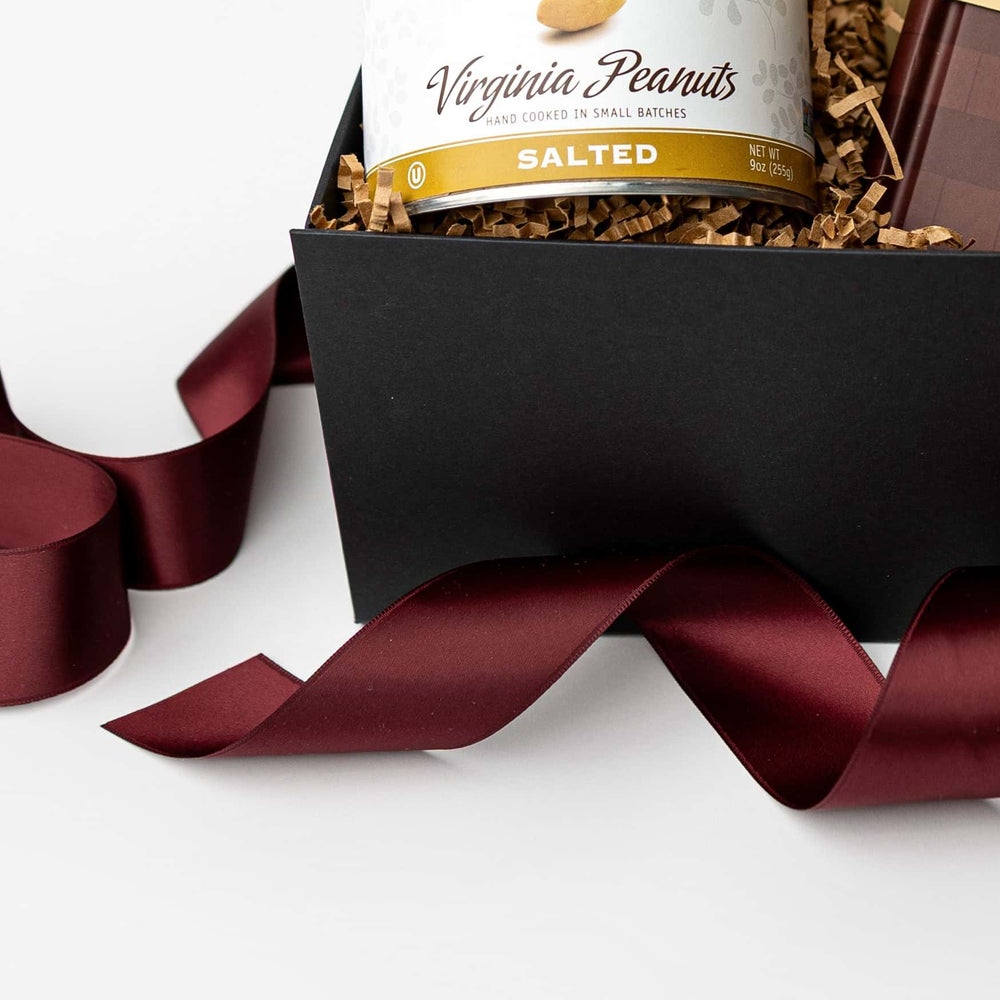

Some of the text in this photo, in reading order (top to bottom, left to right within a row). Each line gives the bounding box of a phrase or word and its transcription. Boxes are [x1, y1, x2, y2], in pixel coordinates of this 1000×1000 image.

[426, 49, 738, 122] Virginia Peanuts
[487, 107, 686, 126] HAND COOKED IN SMALL BATCHES
[518, 144, 657, 169] SALTED
[749, 144, 780, 160] NET WT
[750, 159, 793, 182] 9oz (255g)
